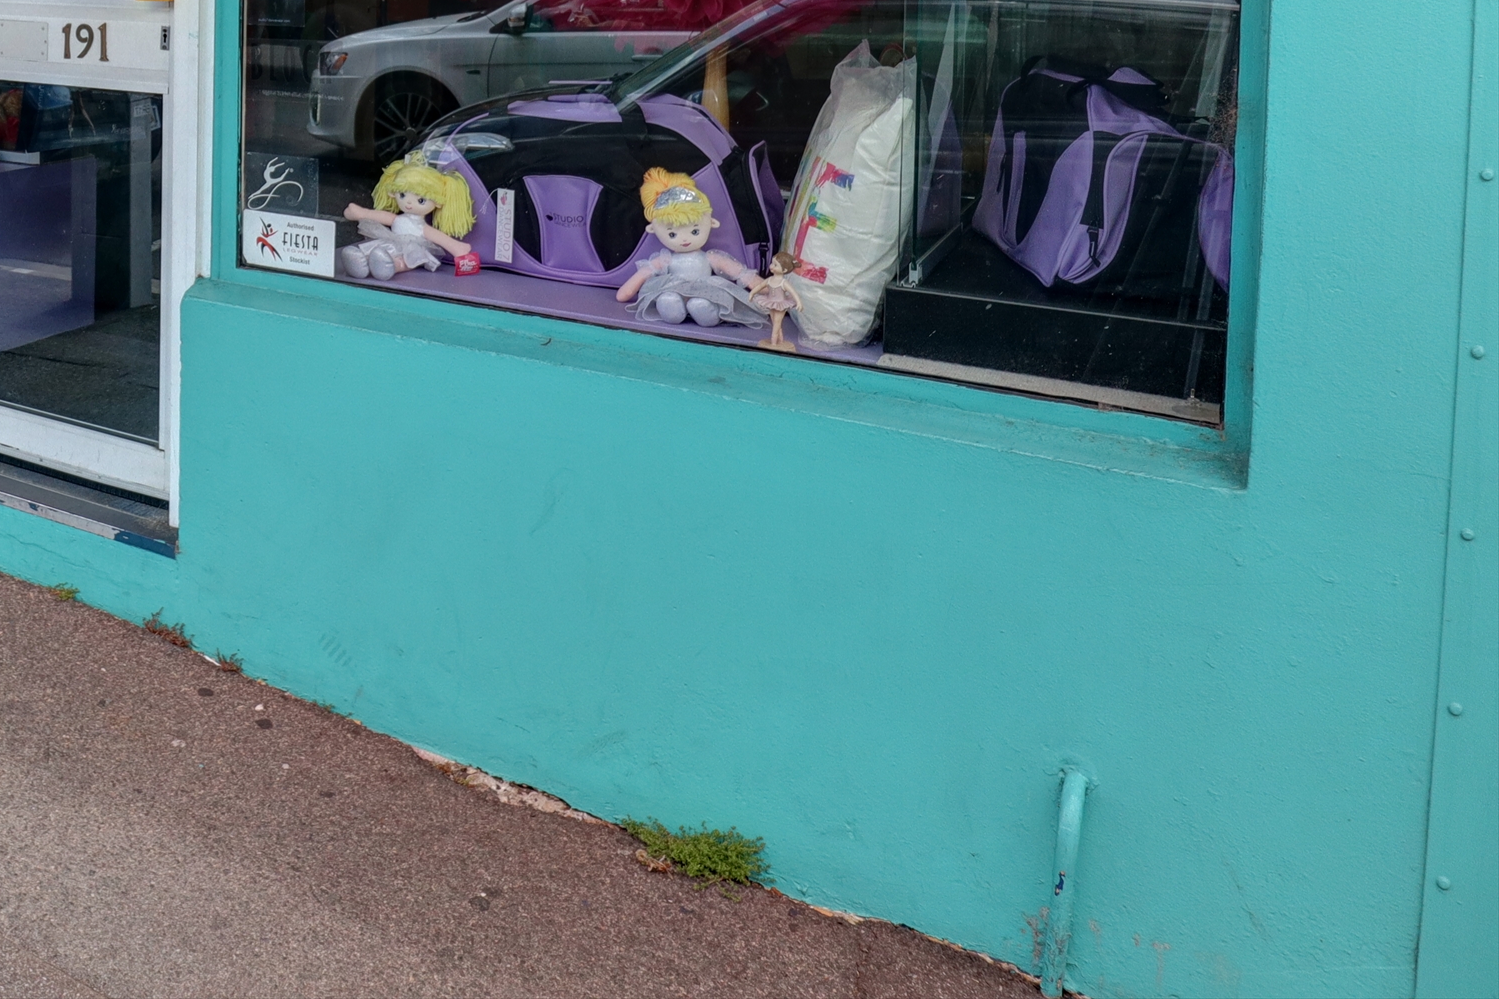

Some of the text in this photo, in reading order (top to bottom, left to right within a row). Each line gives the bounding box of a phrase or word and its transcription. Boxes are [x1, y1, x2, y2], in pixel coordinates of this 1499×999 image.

[61, 22, 110, 62] 191
[552, 212, 584, 223] STUDIO
[287, 222, 315, 231] Authorised
[502, 208, 512, 252] STUDIO
[282, 231, 319, 251] FIESTA
[289, 256, 310, 265] Stockist
